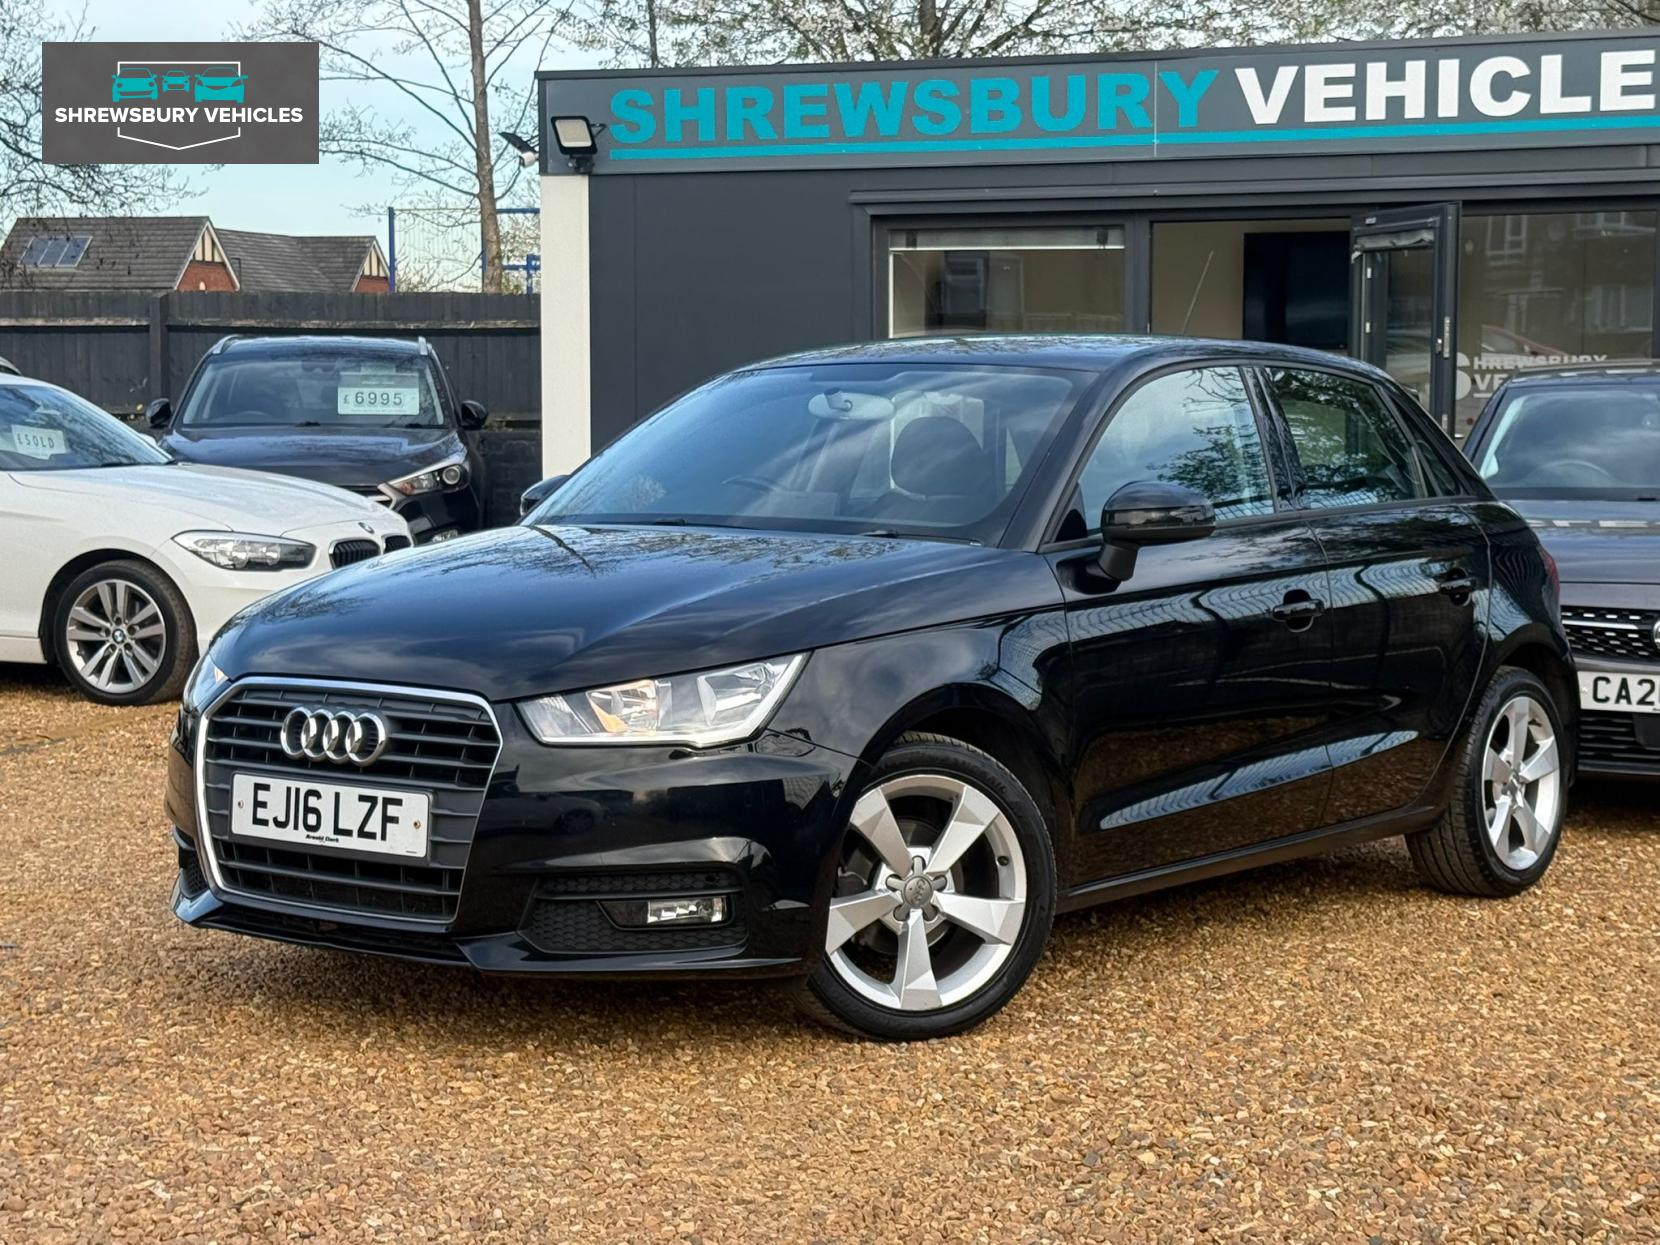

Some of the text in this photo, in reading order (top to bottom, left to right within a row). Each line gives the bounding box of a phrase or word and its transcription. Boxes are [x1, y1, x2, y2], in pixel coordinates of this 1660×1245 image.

[609, 49, 1656, 144] SHREWSBURY VEHICLE
[1592, 676, 1660, 706] CA2
[252, 782, 403, 841] EJ16 LZF
